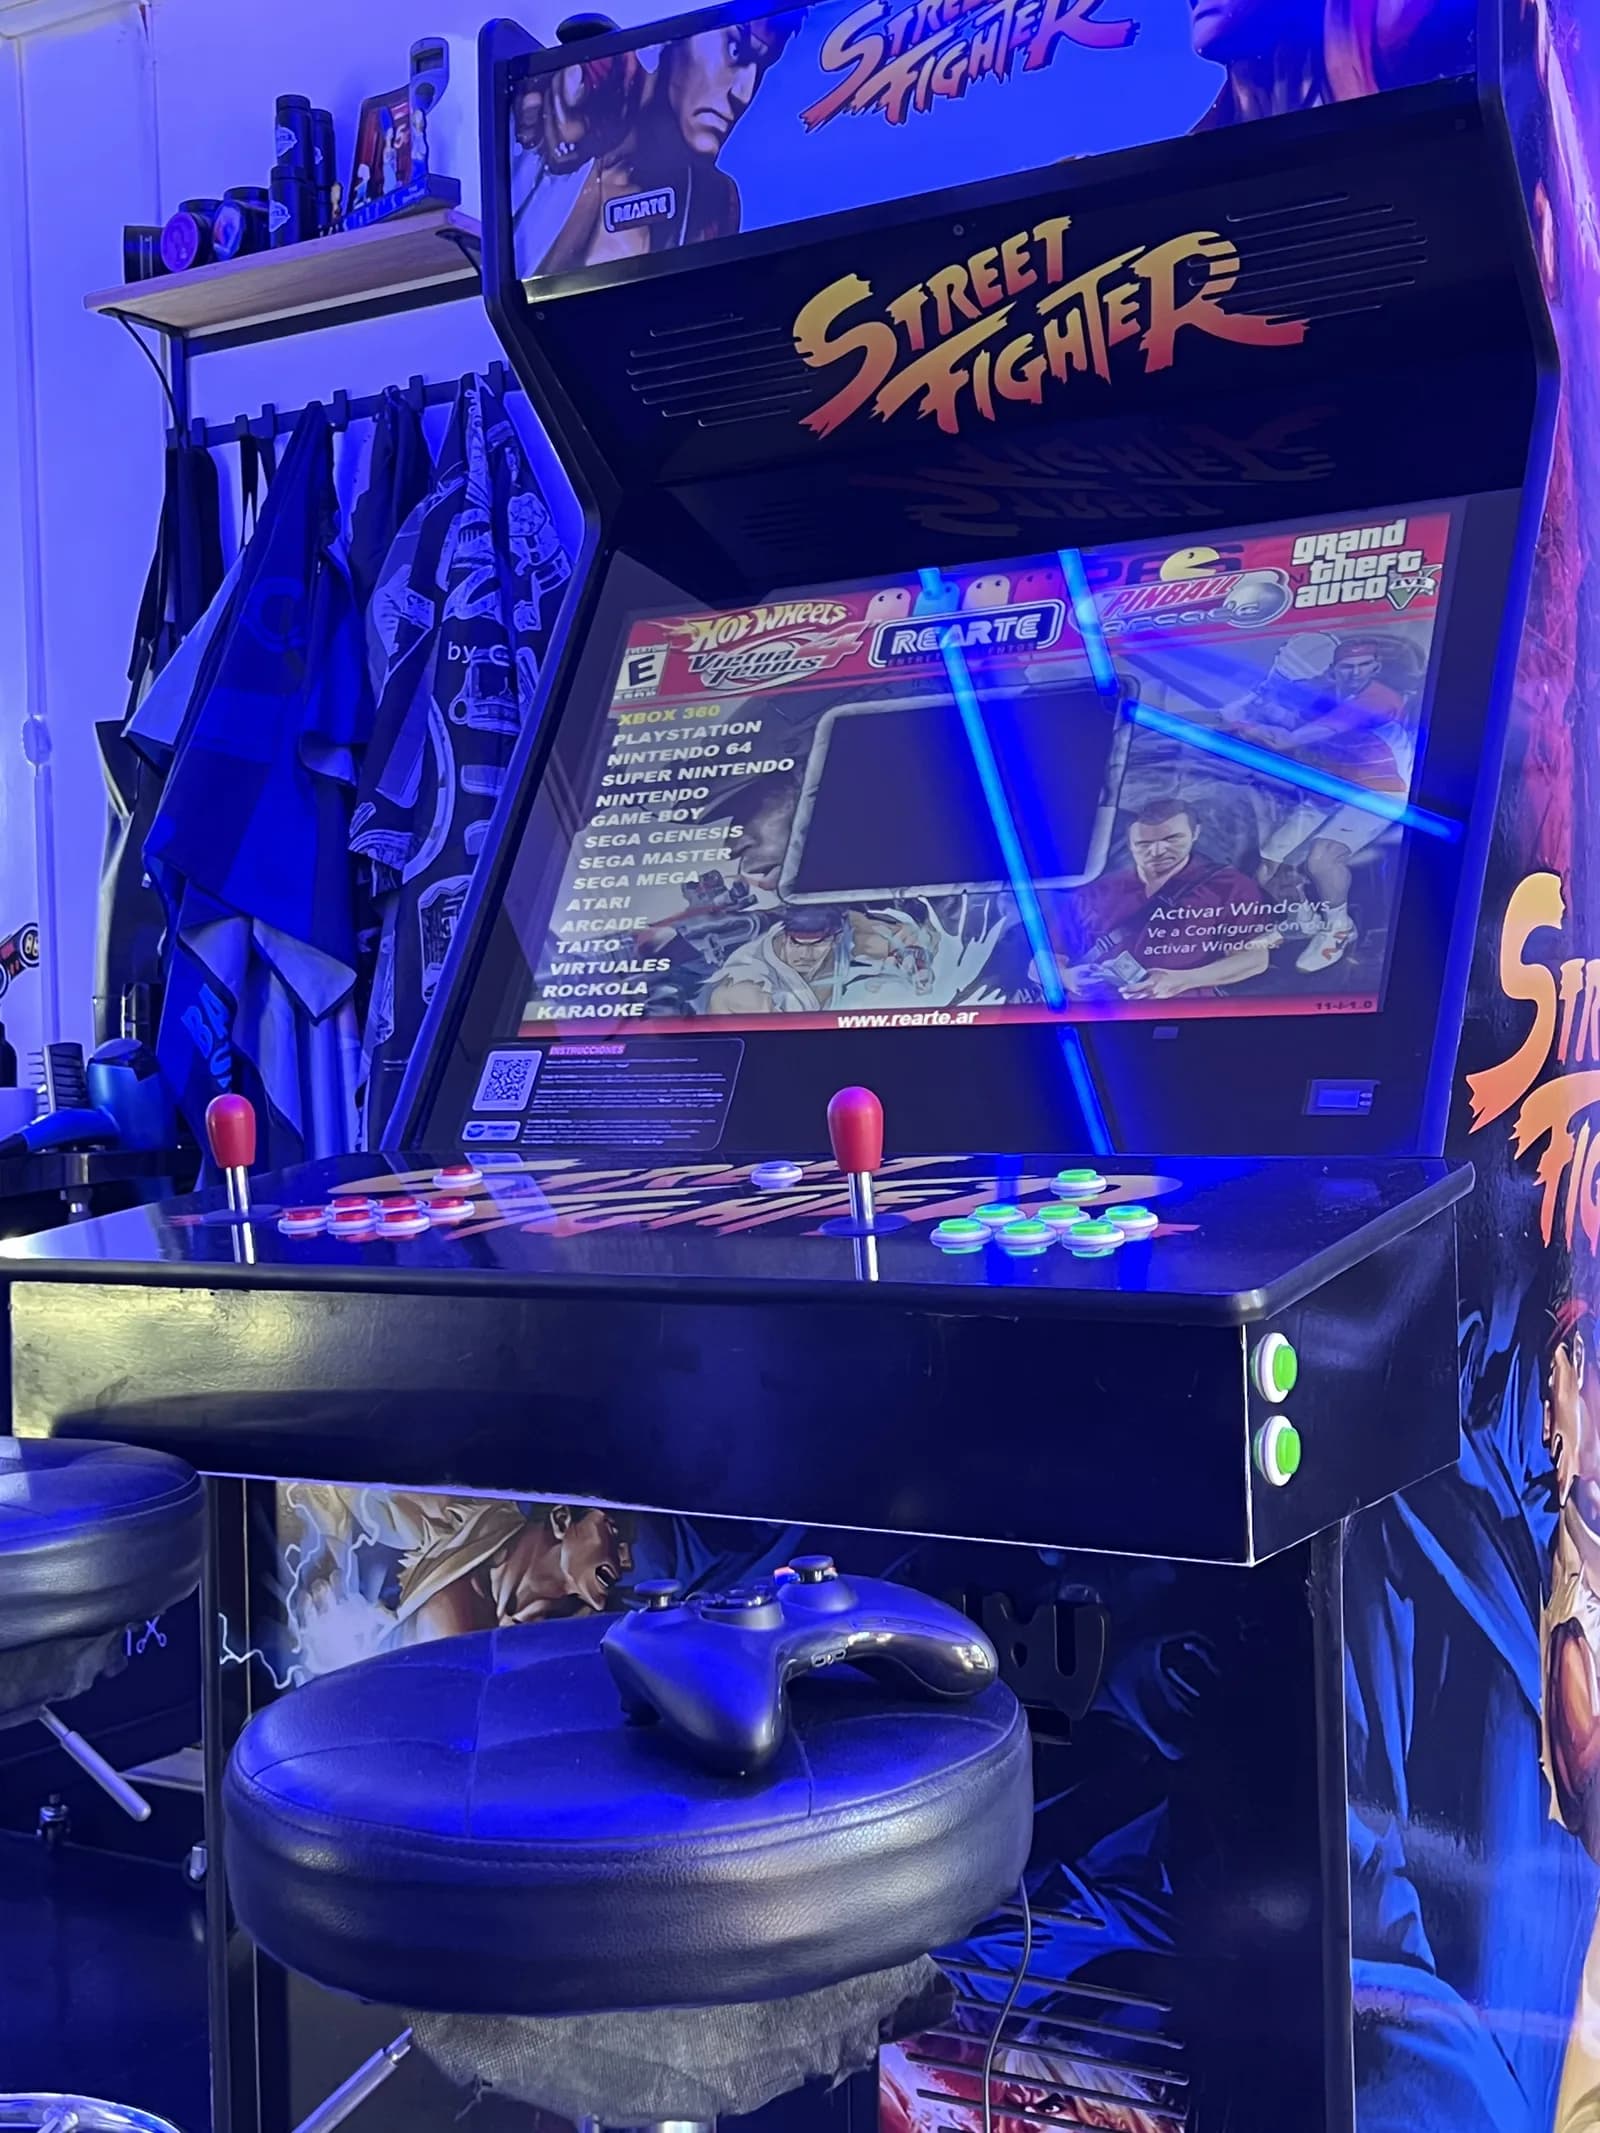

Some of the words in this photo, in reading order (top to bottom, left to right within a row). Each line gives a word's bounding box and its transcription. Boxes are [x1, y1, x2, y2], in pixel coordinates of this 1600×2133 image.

[613, 196, 667, 223] REARTE
[793, 216, 1072, 439] STREET
[869, 231, 1309, 434] FIGHTER
[1291, 519, 1407, 565] grand
[1310, 550, 1423, 584] theft
[1103, 574, 1241, 617] PINBALL
[1294, 577, 1388, 608] auto
[891, 613, 1041, 655] REARTE
[448, 641, 477, 664] by
[690, 649, 794, 672] Virtua
[629, 654, 657, 687] E
[708, 657, 823, 686] Tennis
[618, 709, 676, 726] XBOX
[683, 705, 721, 719] 360
[612, 720, 762, 747] PLAYSTATION
[607, 745, 720, 766] NINTENDO
[726, 741, 752, 755] 64
[601, 770, 672, 786] SUPER
[677, 759, 794, 780] NINTENDO
[596, 787, 709, 808] NINTENDO
[591, 811, 651, 827] GAME
[658, 807, 705, 822] BOY
[584, 834, 641, 848] SEGA
[648, 825, 744, 843] GENESIS
[578, 855, 635, 869] SEGA
[642, 848, 732, 865] MASTER
[573, 875, 629, 890] SEGA
[636, 871, 700, 886] MEGA
[566, 896, 631, 911] ATARI
[1150, 905, 1224, 920] Activar
[1230, 899, 1330, 917] Windows
[560, 917, 648, 933] ARCADE
[1148, 928, 1166, 938] Ve
[1171, 928, 1180, 938] a
[1185, 919, 1299, 937] Configuración
[557, 939, 621, 954] TAITO
[1144, 943, 1196, 955] activar
[551, 958, 671, 976] VIRTUALES
[542, 982, 648, 998] ROCKOLA
[537, 1003, 645, 1019] KARAOKE
[837, 1010, 979, 1029] www.rearte.ar
[550, 1045, 625, 1056] INSTRUCCIONES
